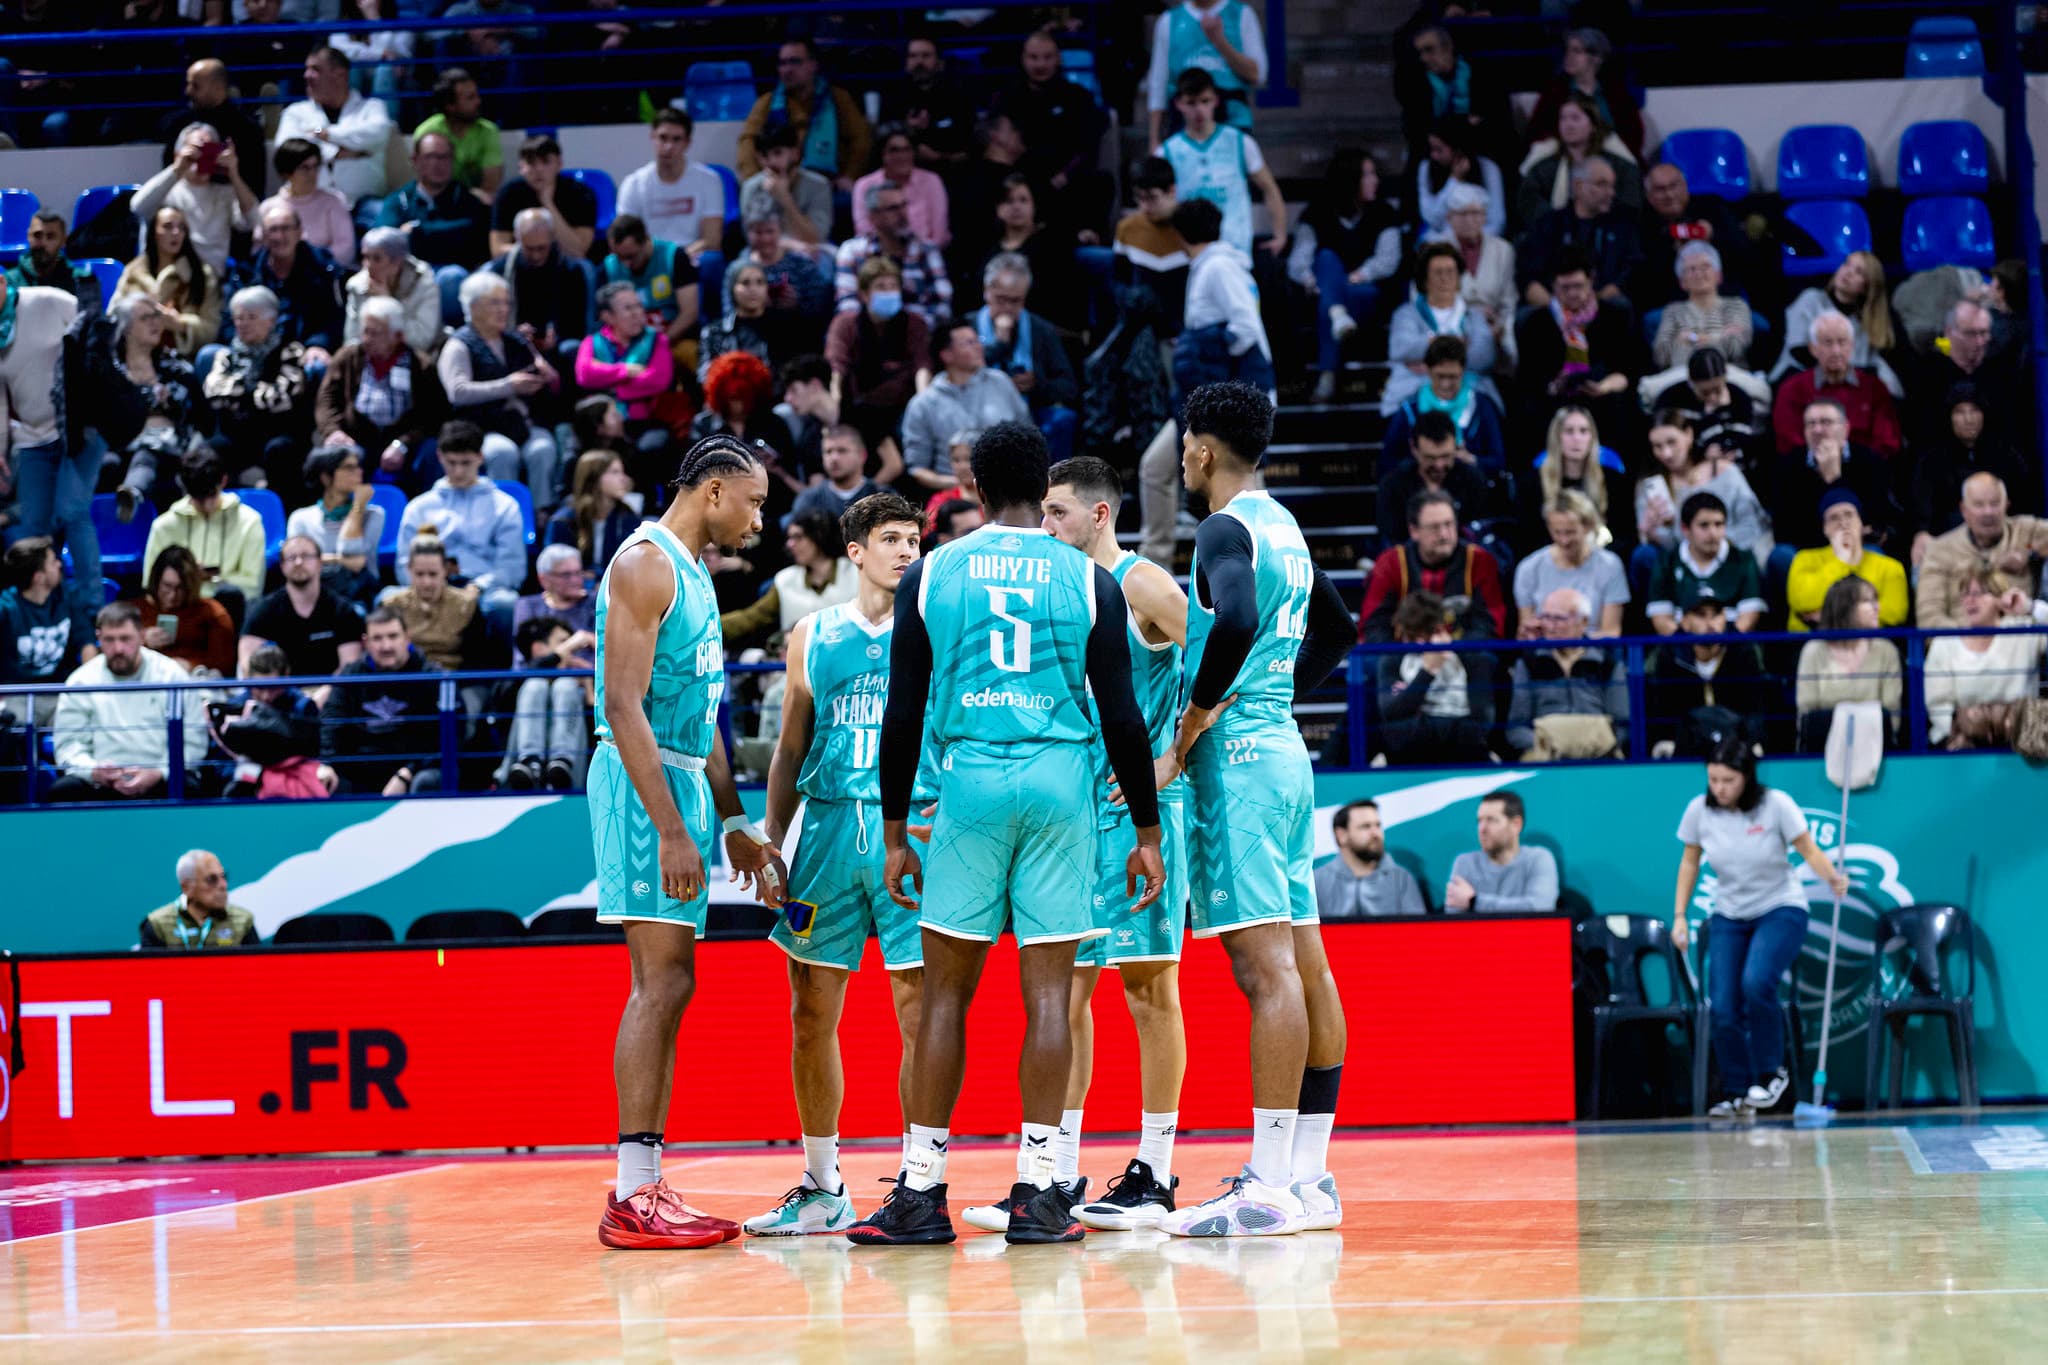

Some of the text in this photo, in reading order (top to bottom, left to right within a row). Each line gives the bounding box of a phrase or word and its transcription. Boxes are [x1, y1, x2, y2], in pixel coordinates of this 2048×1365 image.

[968, 554, 1052, 584] WHYTE
[984, 585, 1034, 673] 5
[961, 687, 1054, 710] edenauto
[852, 728, 878, 769] 11
[1224, 736, 1259, 765] 22
